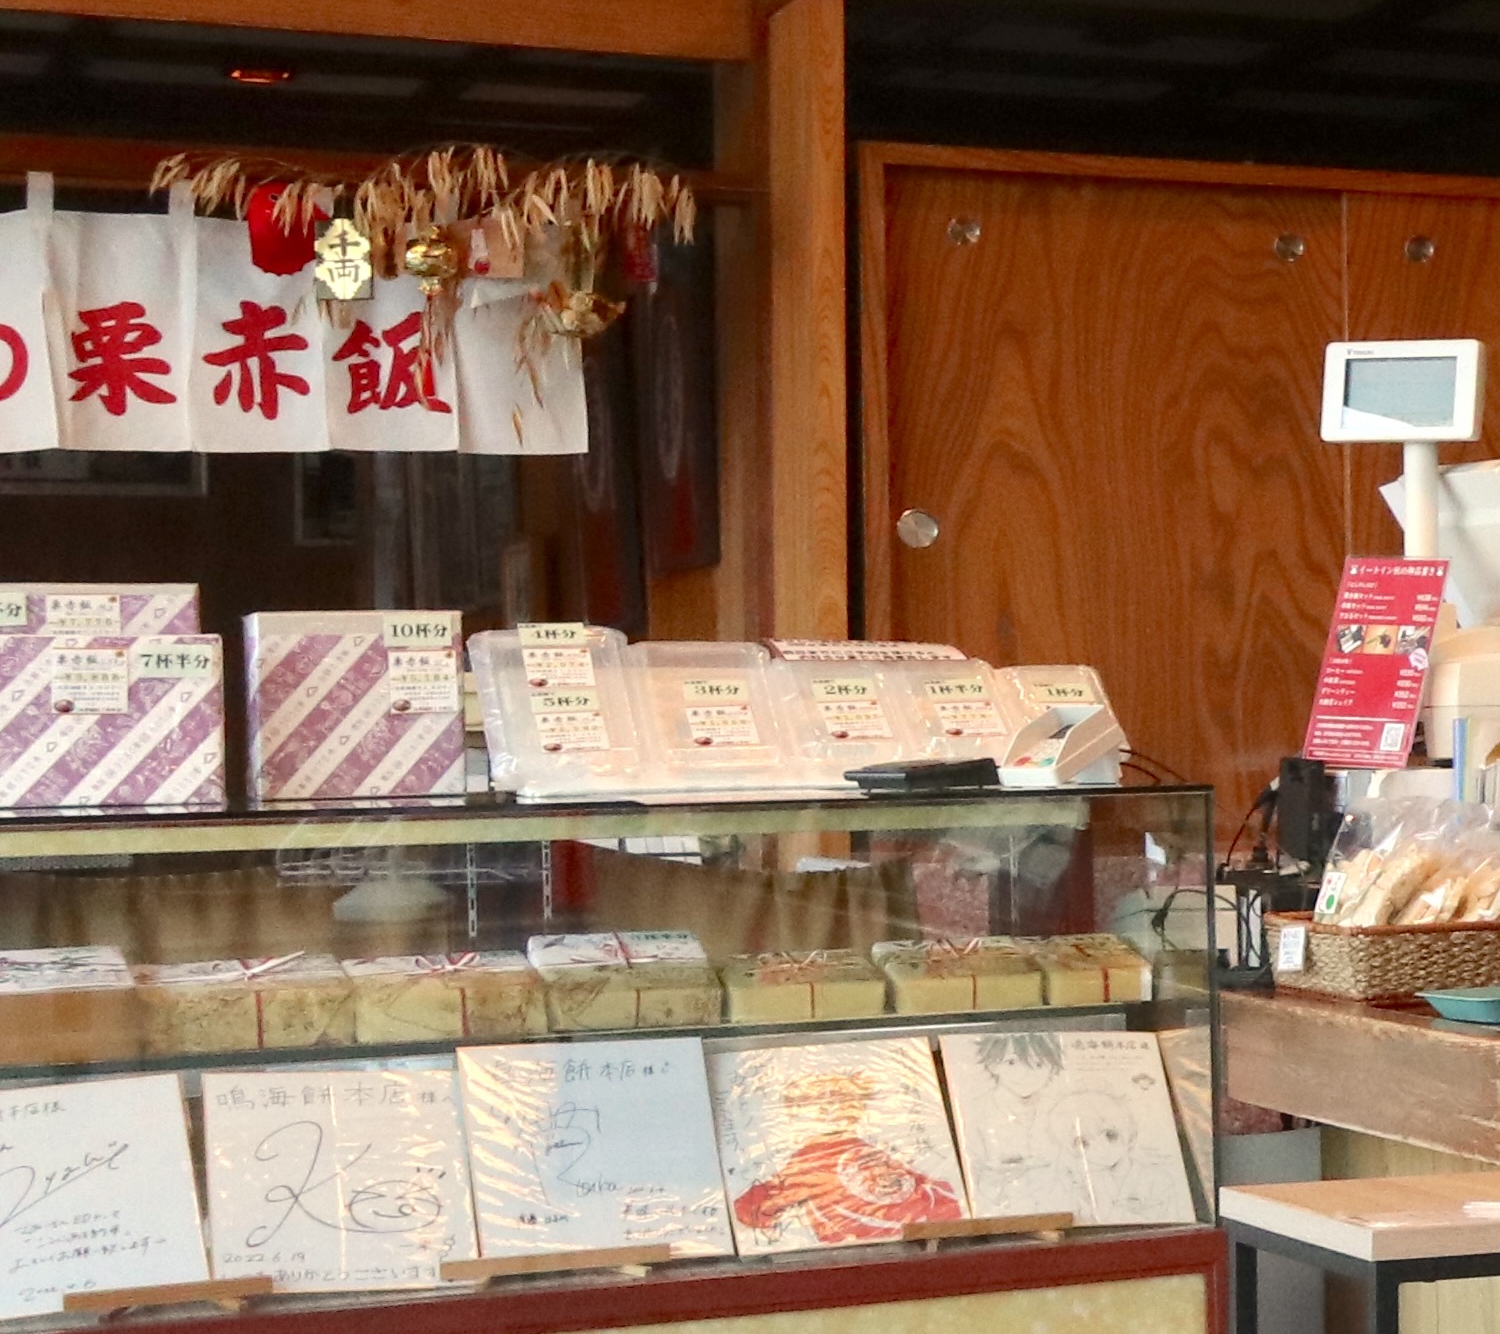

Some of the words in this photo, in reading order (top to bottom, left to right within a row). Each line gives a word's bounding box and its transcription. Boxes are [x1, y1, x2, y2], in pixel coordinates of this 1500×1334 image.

[327, 229, 364, 284] 千両
[390, 623, 449, 639] 10杯分
[140, 652, 210, 671] 7杯半分
